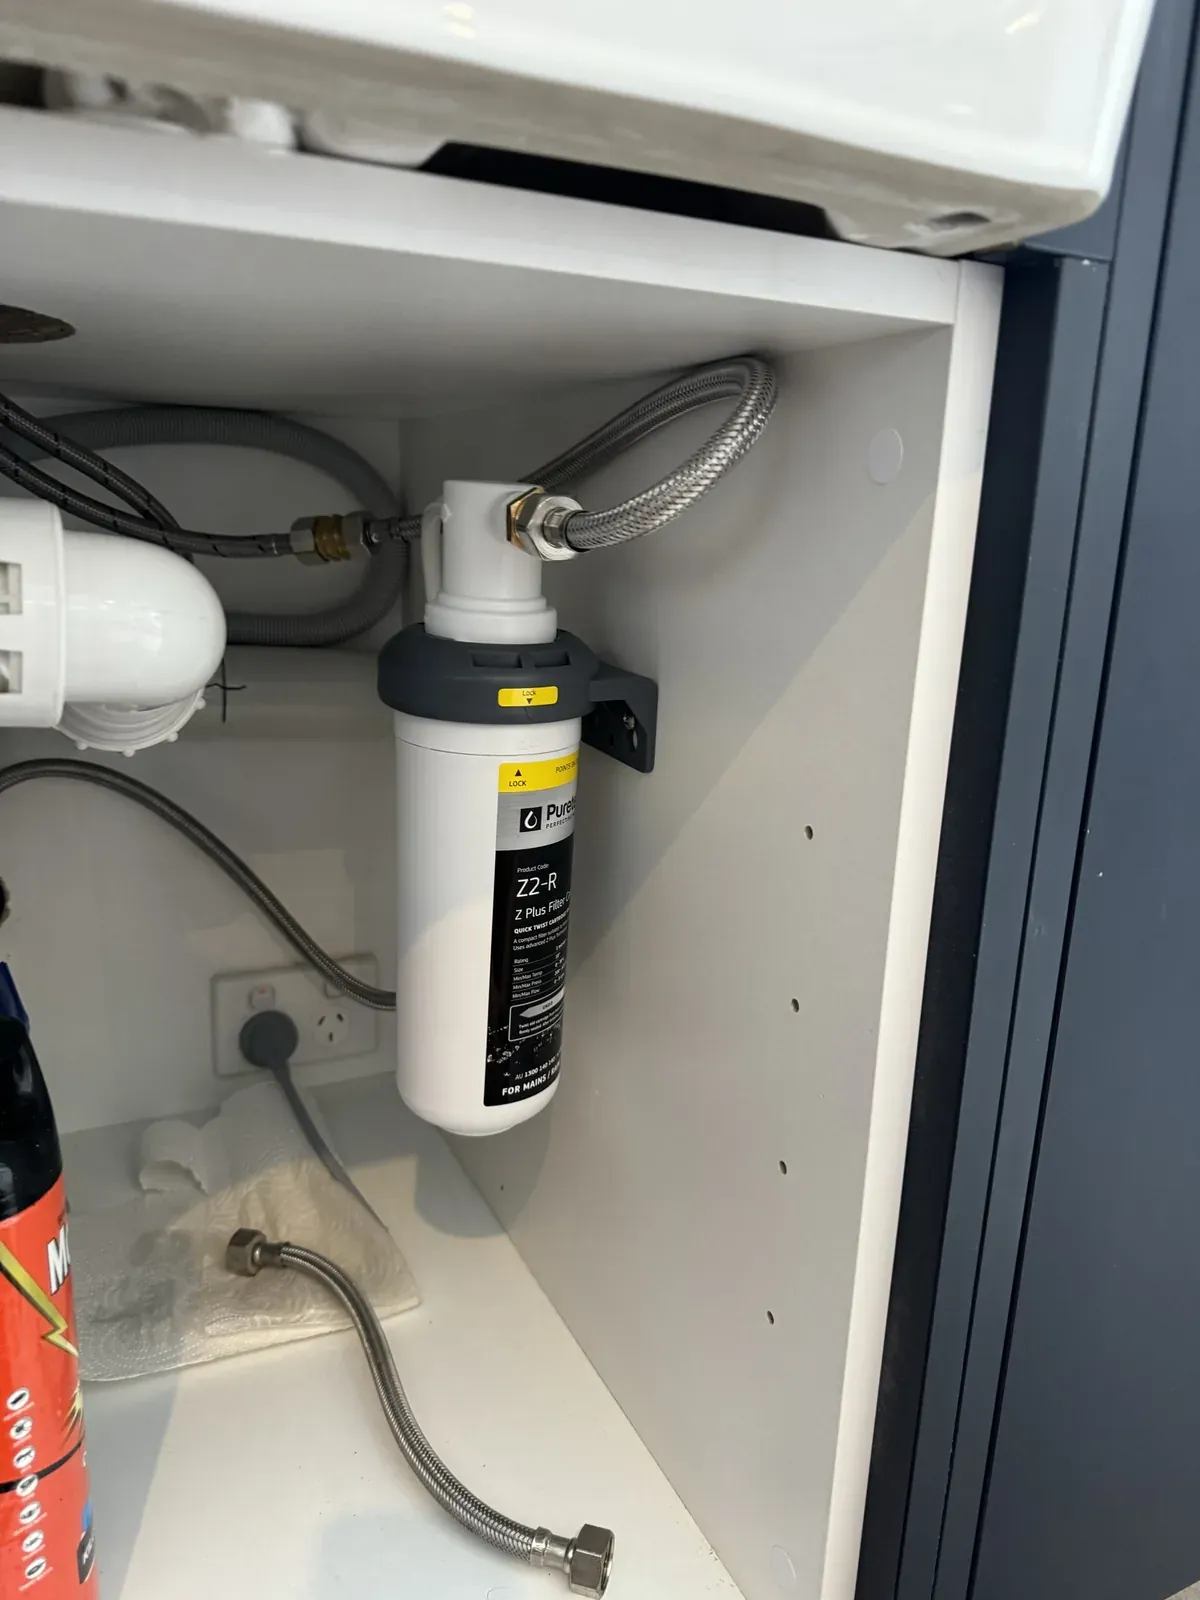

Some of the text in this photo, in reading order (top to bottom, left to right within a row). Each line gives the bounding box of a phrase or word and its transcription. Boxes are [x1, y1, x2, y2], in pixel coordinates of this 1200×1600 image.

[516, 872, 557, 898] Z2-R
[515, 897, 565, 920] Z Plus Filter
[514, 926, 532, 934] QUICK
[533, 921, 548, 930] TWIST
[524, 1067, 539, 1078] 1300
[501, 1084, 521, 1097] FOR
[522, 1073, 547, 1092] MAINS
[46, 1222, 71, 1296] M
